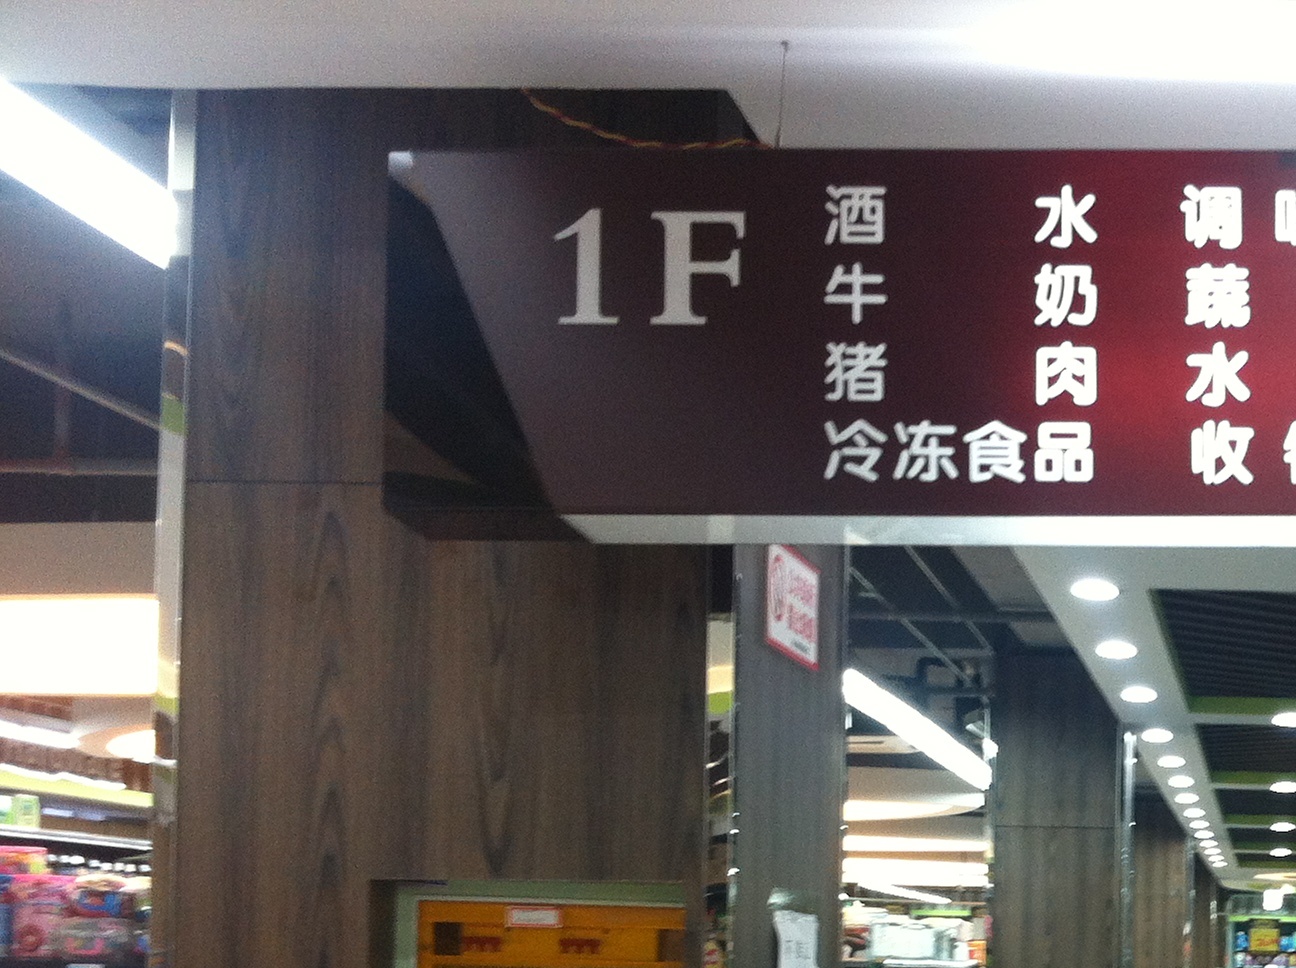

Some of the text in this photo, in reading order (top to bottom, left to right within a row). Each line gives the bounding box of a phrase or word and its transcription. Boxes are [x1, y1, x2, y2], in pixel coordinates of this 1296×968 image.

[554, 208, 745, 325] 1F
[825, 420, 1094, 483] 冷冻食品
